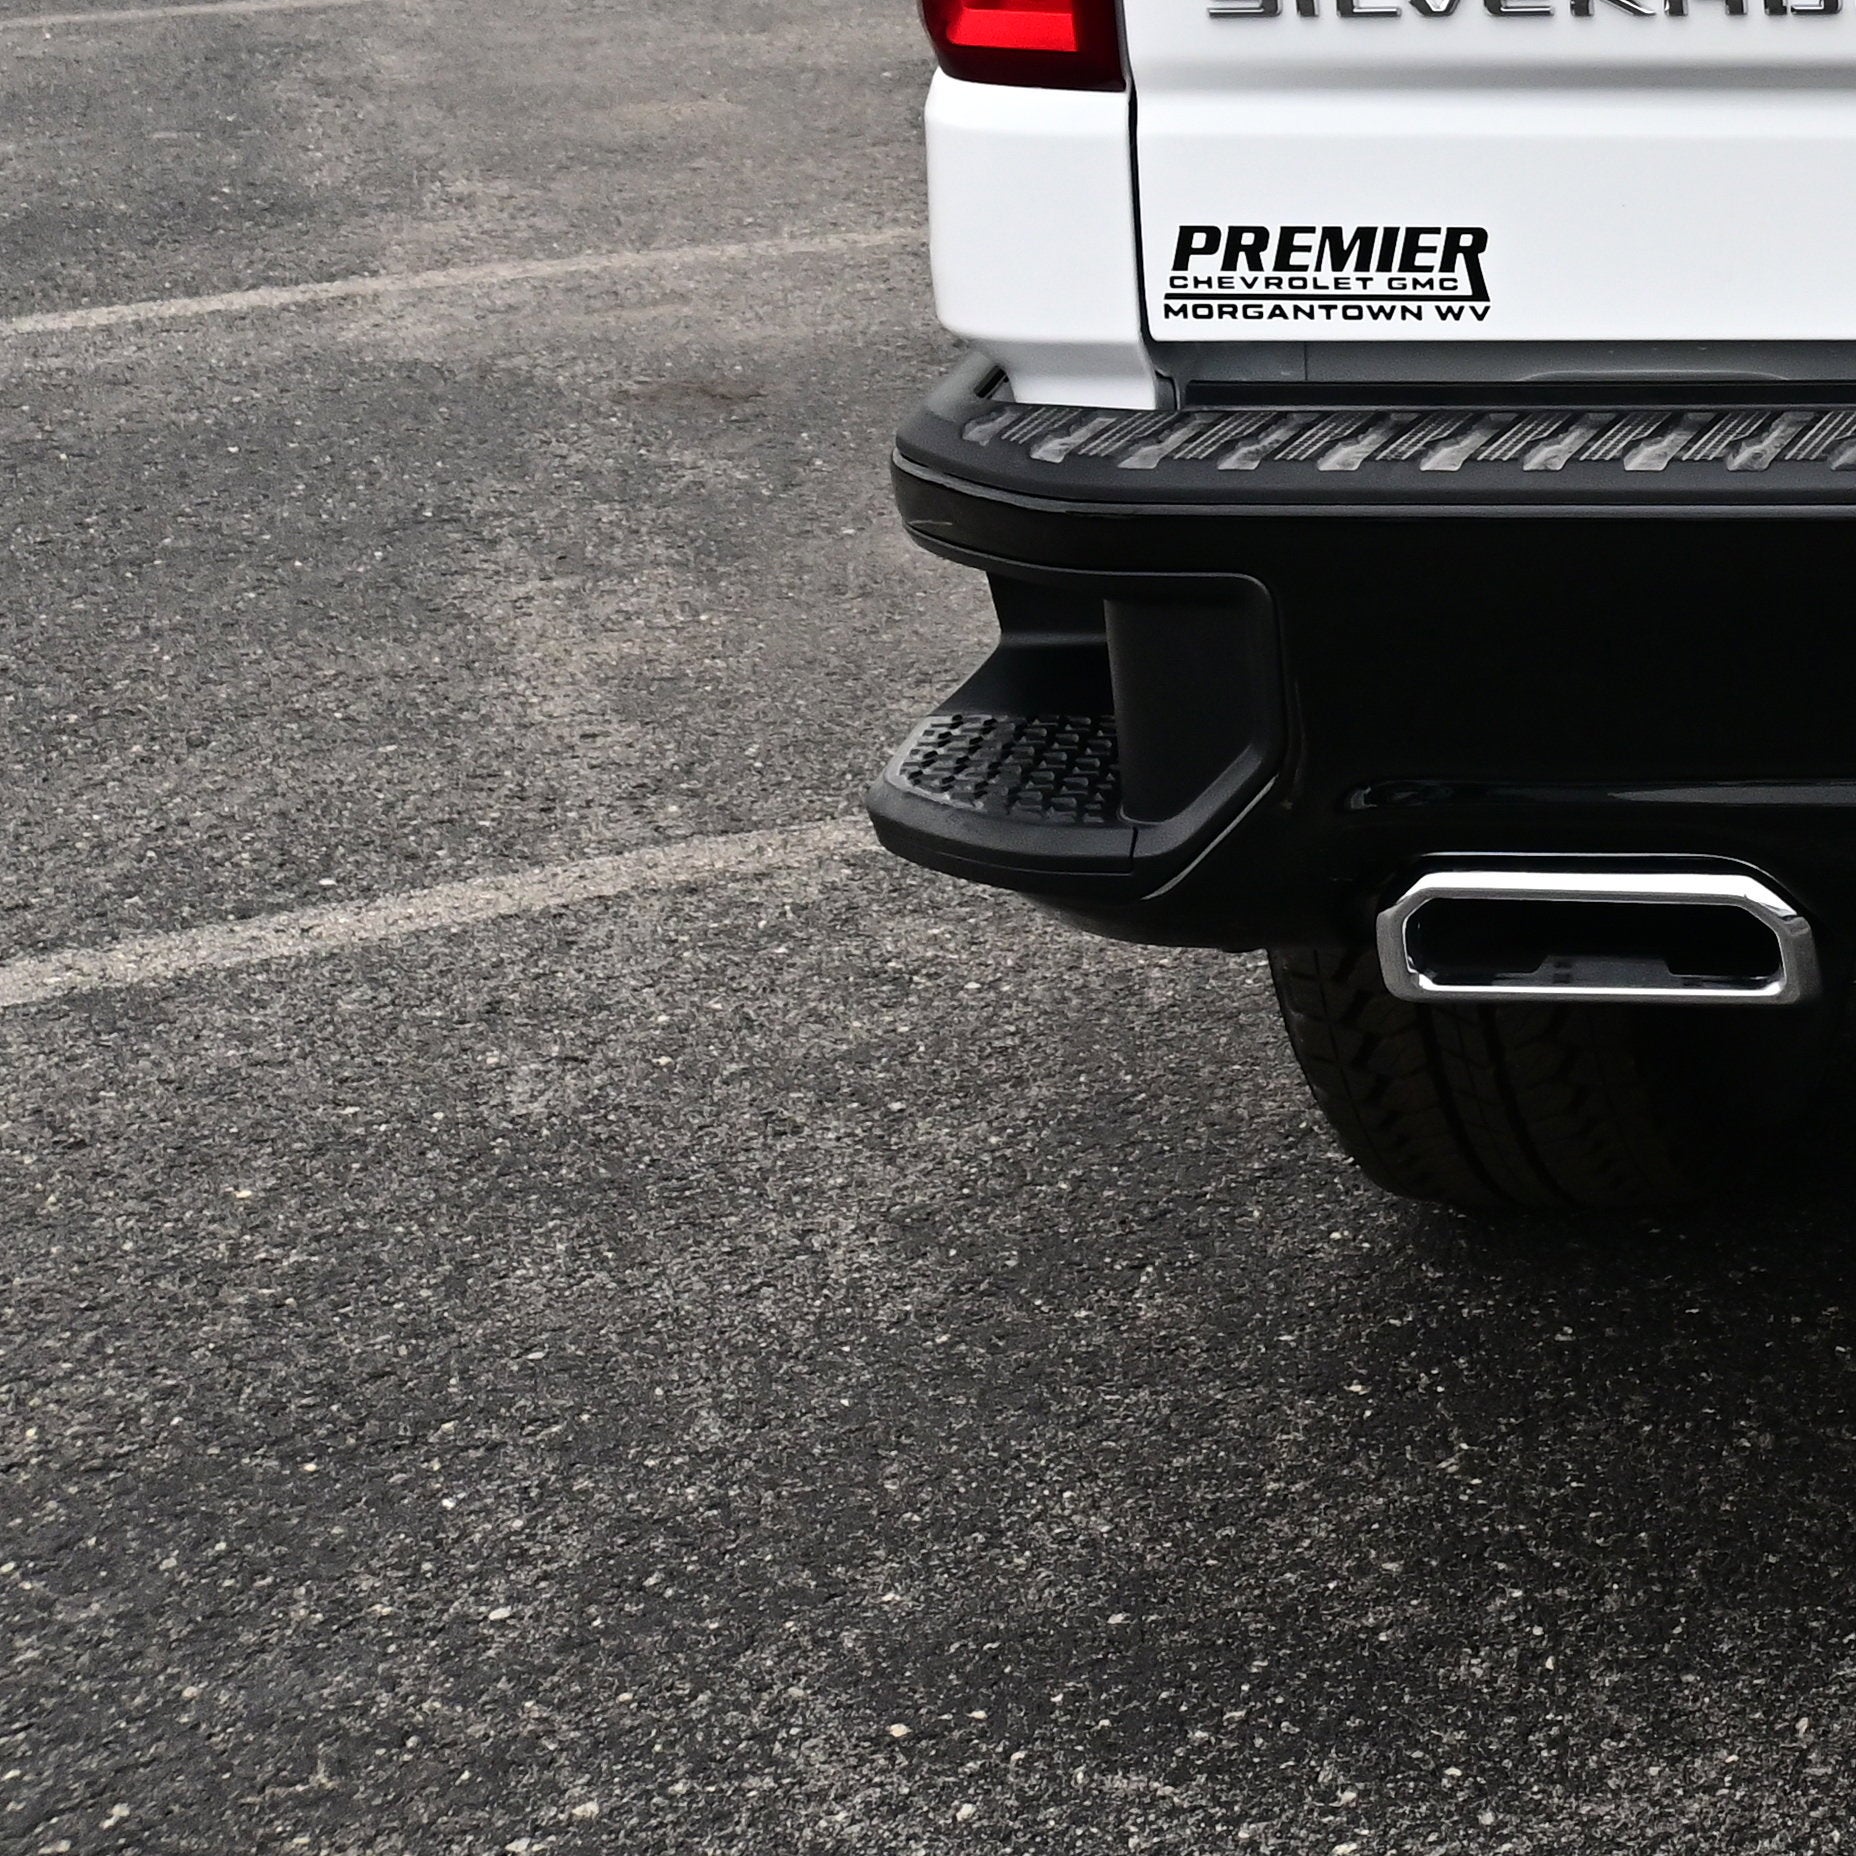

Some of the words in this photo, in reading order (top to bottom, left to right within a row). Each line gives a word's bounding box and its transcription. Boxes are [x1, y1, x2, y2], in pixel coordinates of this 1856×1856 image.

[1171, 225, 1491, 302] PREMIER
[1168, 275, 1374, 291] CHEVROLET
[1386, 276, 1459, 292] GMC
[1163, 303, 1424, 322] MORGANTOWN
[1434, 304, 1491, 322] WV
